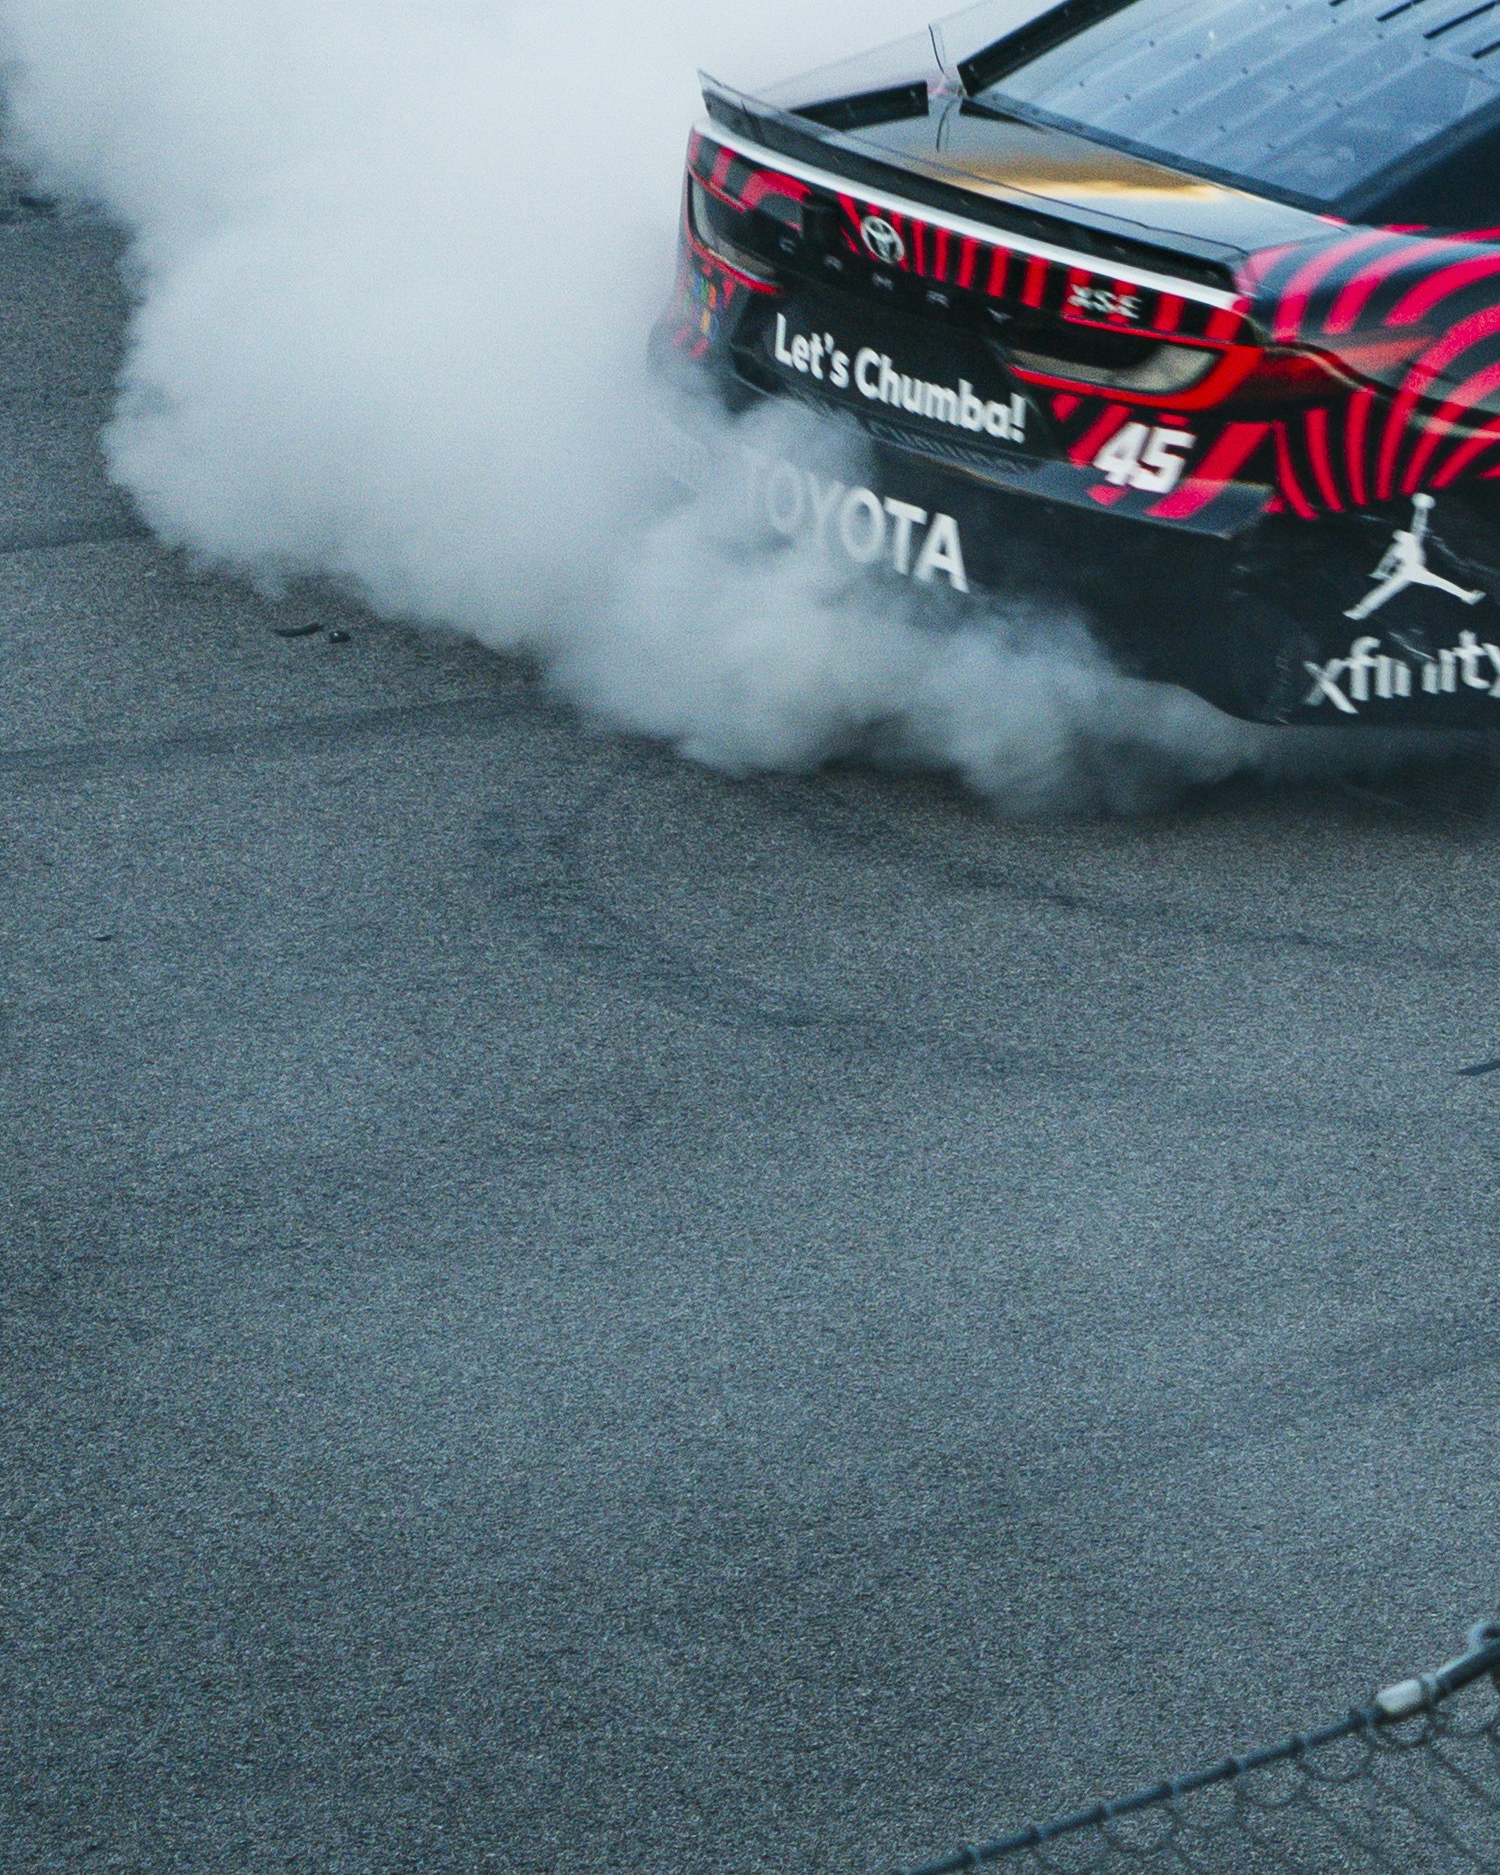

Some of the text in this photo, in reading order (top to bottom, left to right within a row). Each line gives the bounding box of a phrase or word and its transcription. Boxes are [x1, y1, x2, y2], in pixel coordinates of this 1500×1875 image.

[774, 311, 850, 390] Let's
[853, 347, 1027, 445] Chumba!
[1094, 420, 1197, 495] 45
